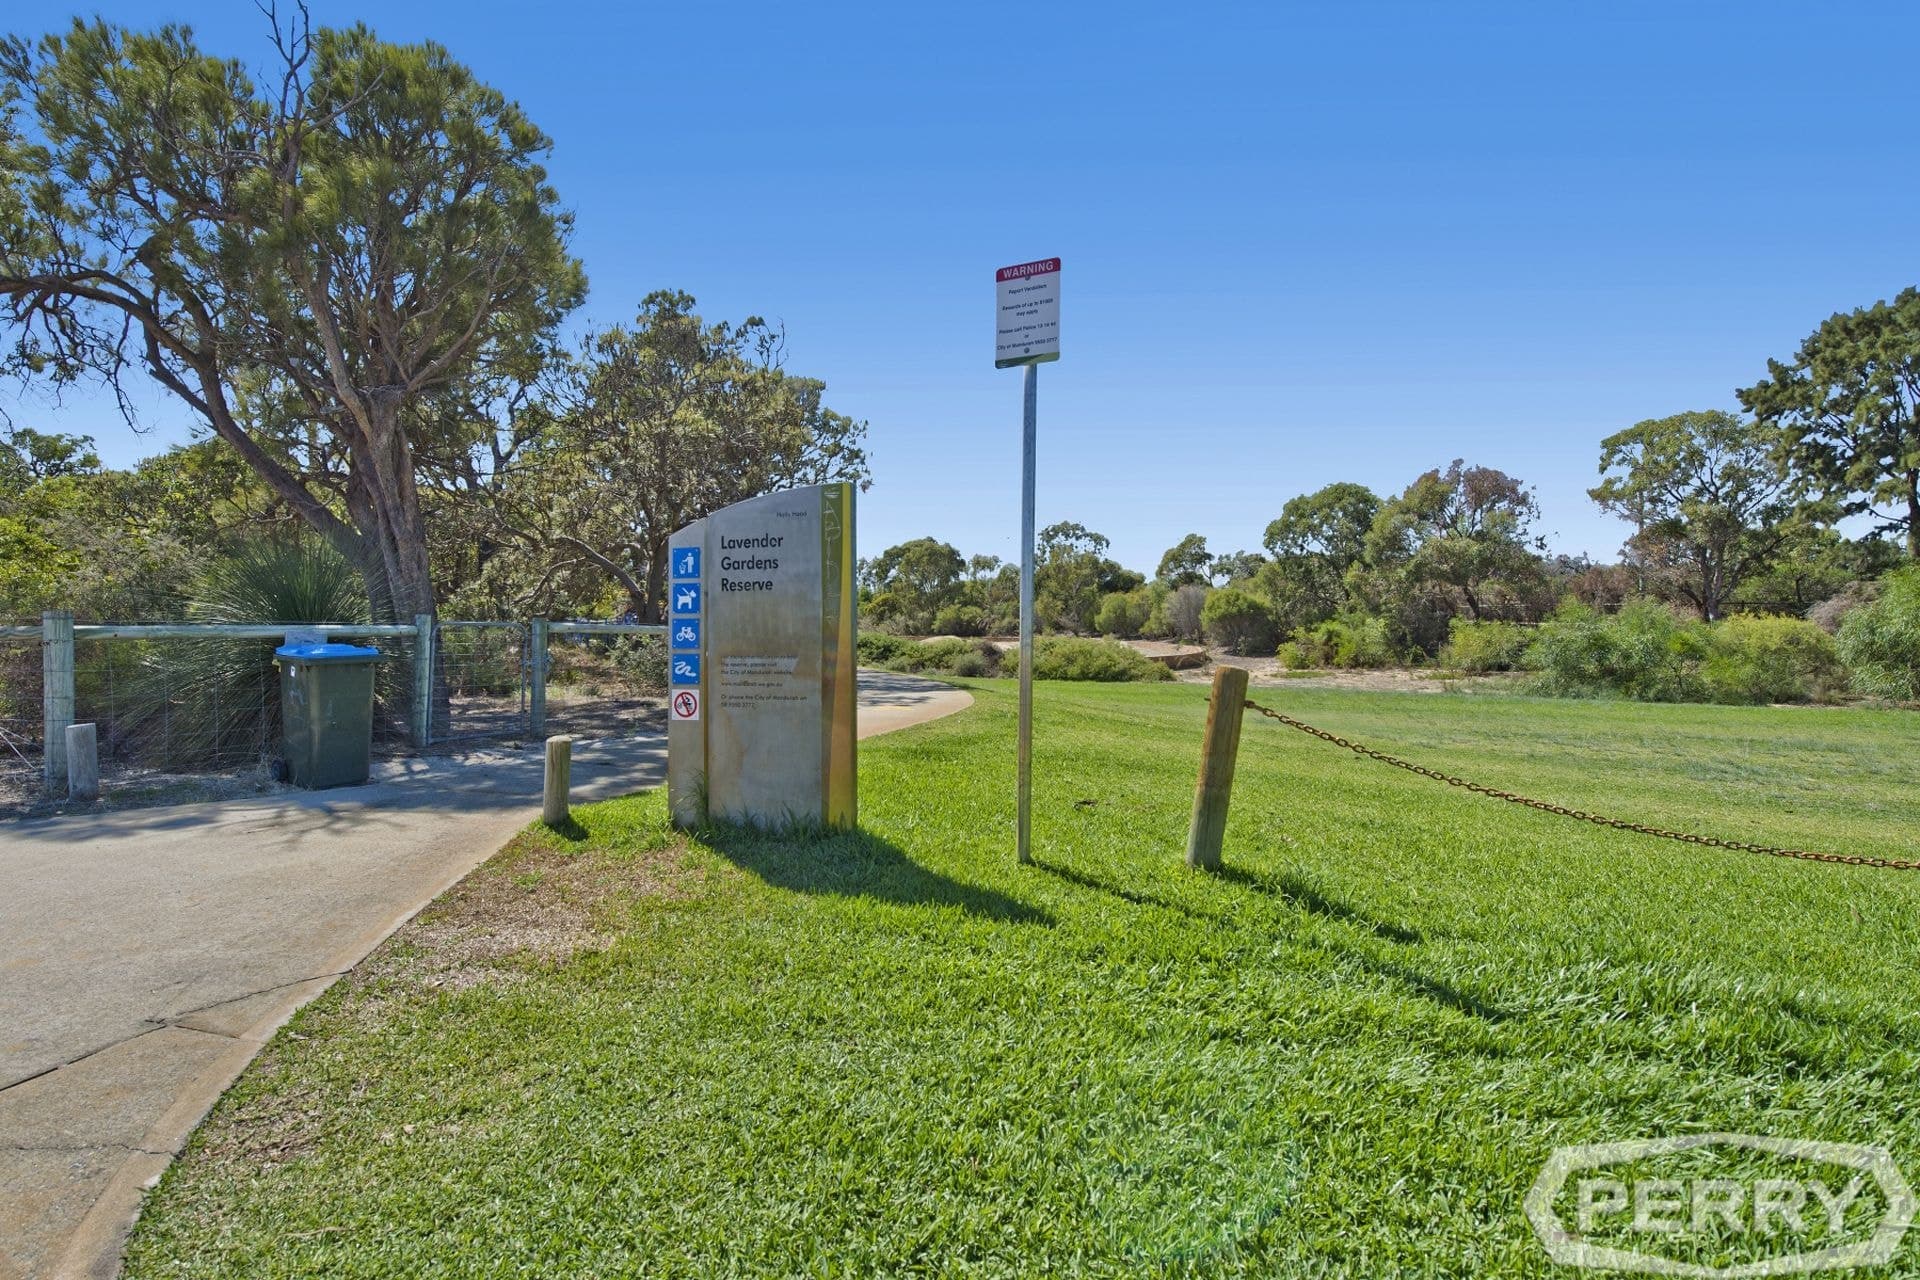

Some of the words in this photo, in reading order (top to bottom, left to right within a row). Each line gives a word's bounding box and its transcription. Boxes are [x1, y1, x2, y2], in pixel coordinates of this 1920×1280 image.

[1003, 261, 1053, 279] WARNING
[1008, 287, 1024, 295] Report
[721, 532, 784, 550] Lavender
[721, 554, 779, 571] Gardens
[721, 577, 774, 592] Reserve
[754, 693, 765, 701] City
